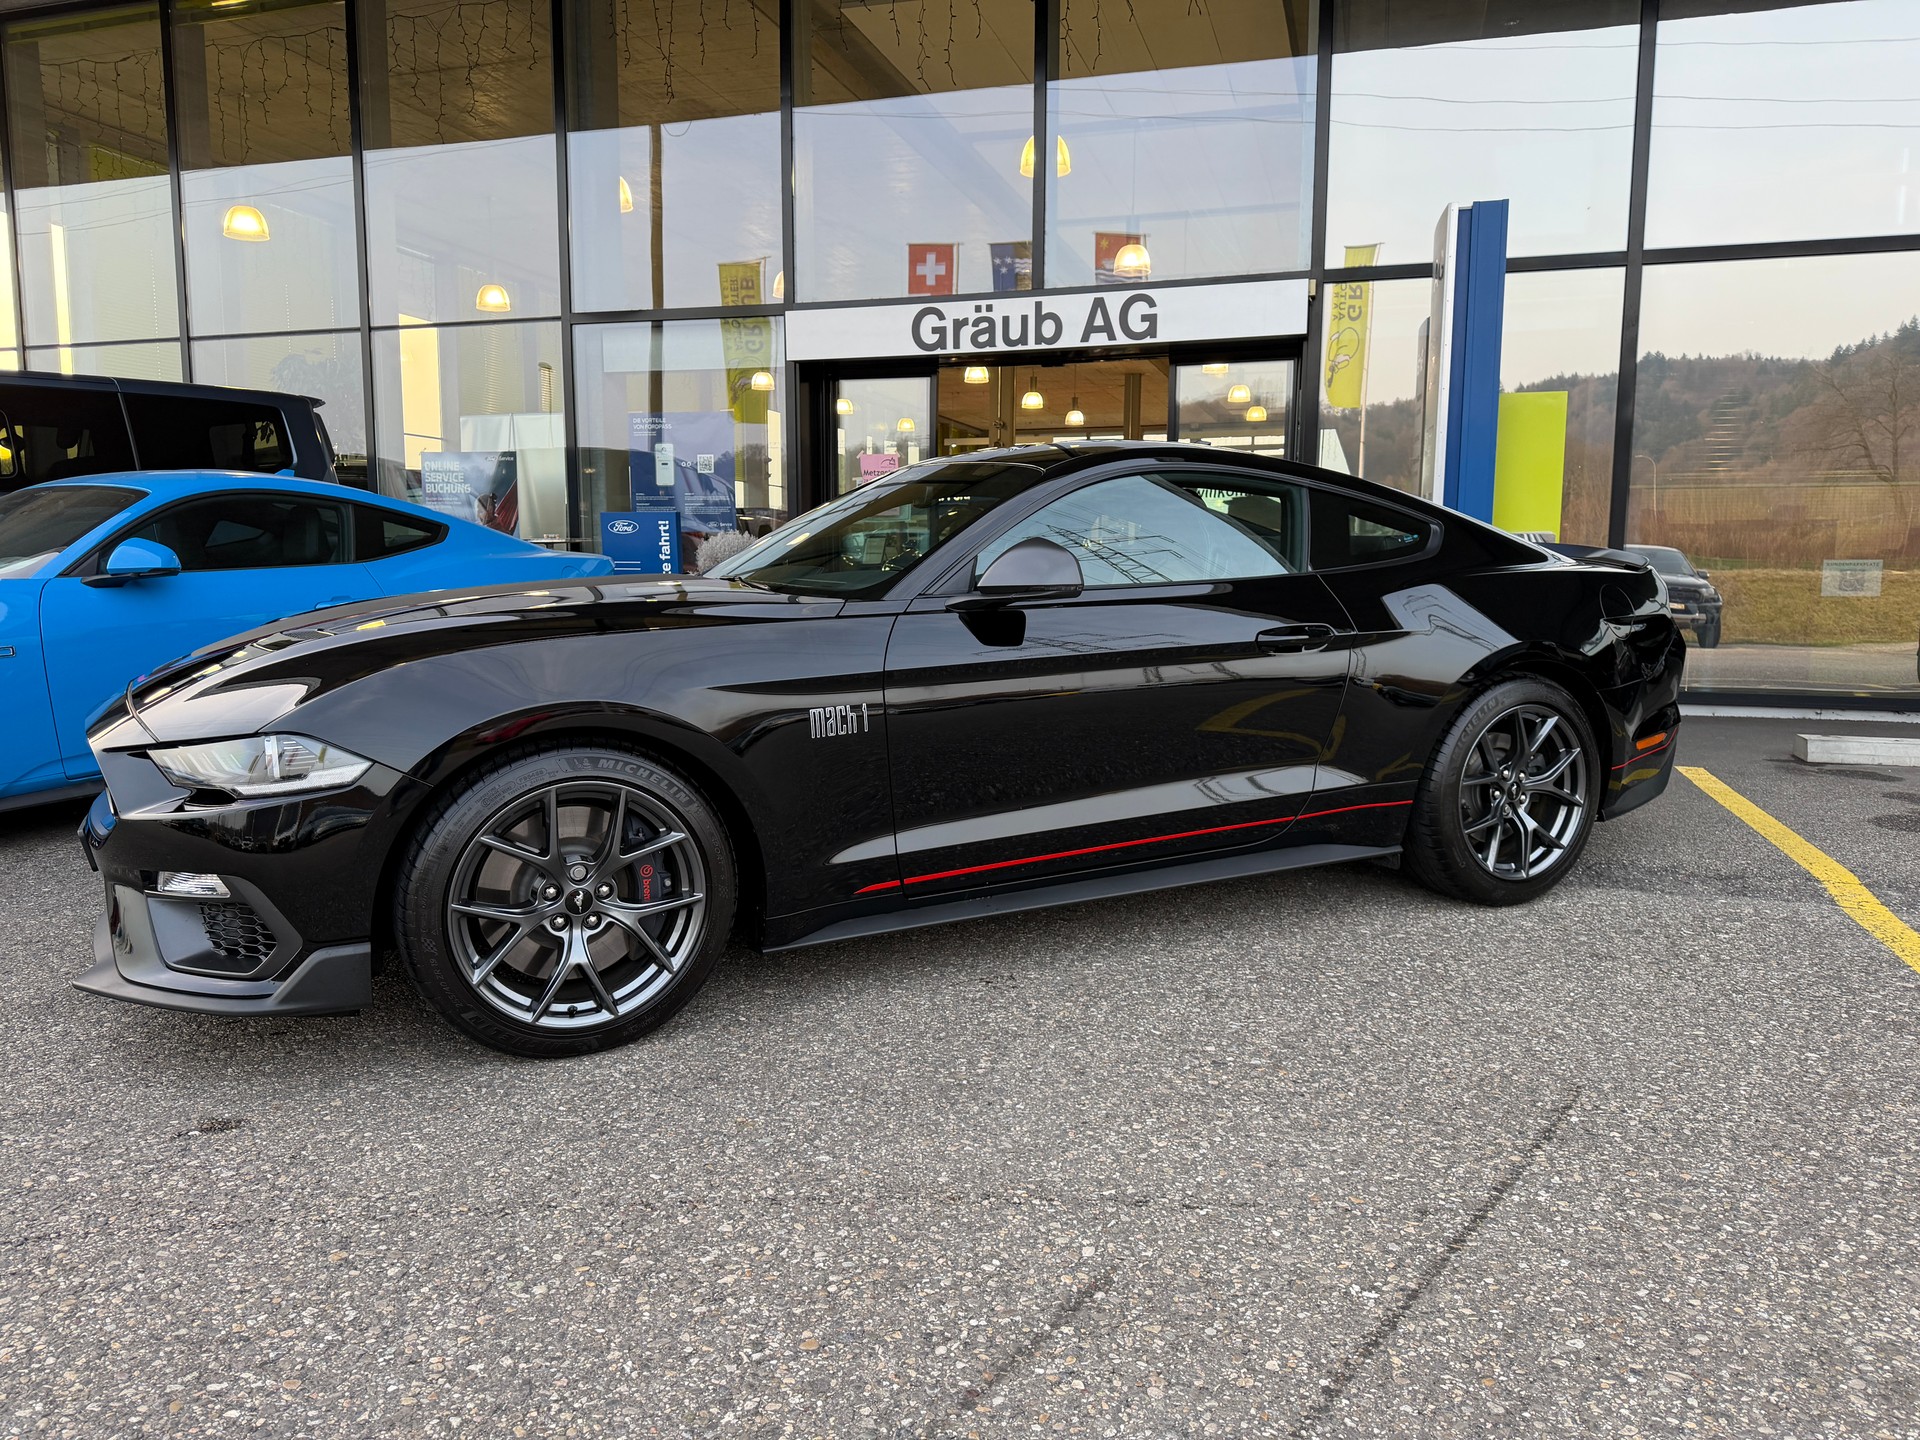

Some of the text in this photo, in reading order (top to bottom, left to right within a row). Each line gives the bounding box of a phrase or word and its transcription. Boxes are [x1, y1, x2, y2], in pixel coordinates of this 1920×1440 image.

[911, 293, 1158, 351] Gräub AG
[424, 461, 460, 471] ONLINE
[425, 473, 464, 482] SERVICE
[426, 484, 471, 493] BUCHUNG
[611, 521, 634, 532] Ford
[657, 520, 671, 560] fahrt!
[861, 702, 869, 732] 1
[598, 758, 690, 803] MICHELIN
